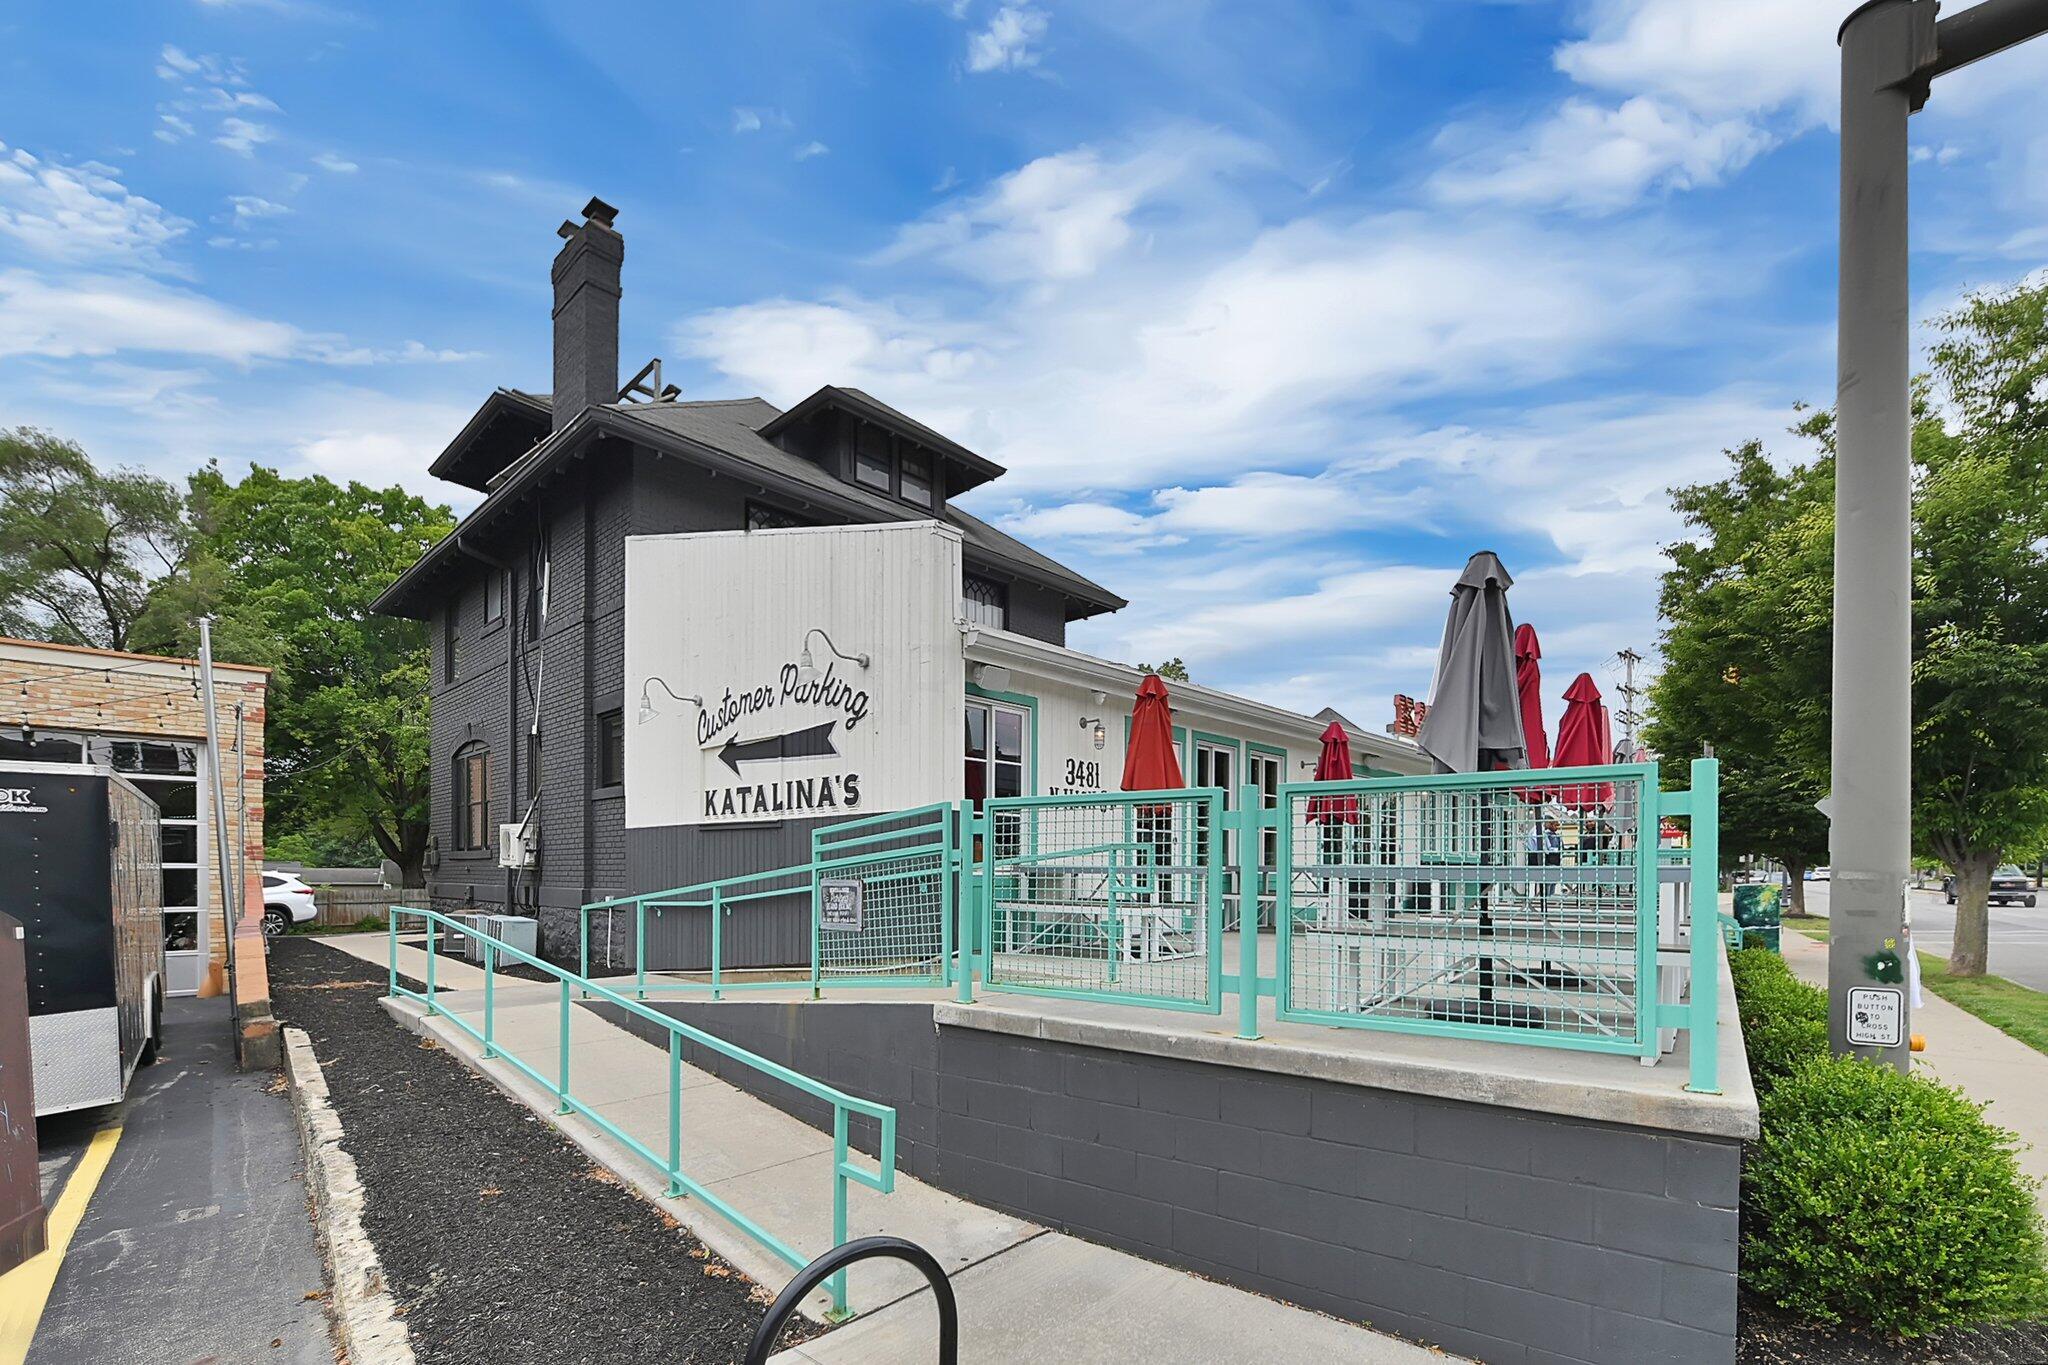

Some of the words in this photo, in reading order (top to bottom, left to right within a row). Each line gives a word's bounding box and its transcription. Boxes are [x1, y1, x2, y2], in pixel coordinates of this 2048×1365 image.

[697, 687, 775, 745] Customer
[780, 661, 869, 731] Parking
[1065, 758, 1101, 789] 3481
[704, 773, 860, 817] KATALINA'S
[1862, 993, 1888, 1001] PUSH
[1857, 1003, 1894, 1011] BUTTON
[1861, 1022, 1889, 1031] CROSS
[1855, 1032, 1876, 1040] HIGH
